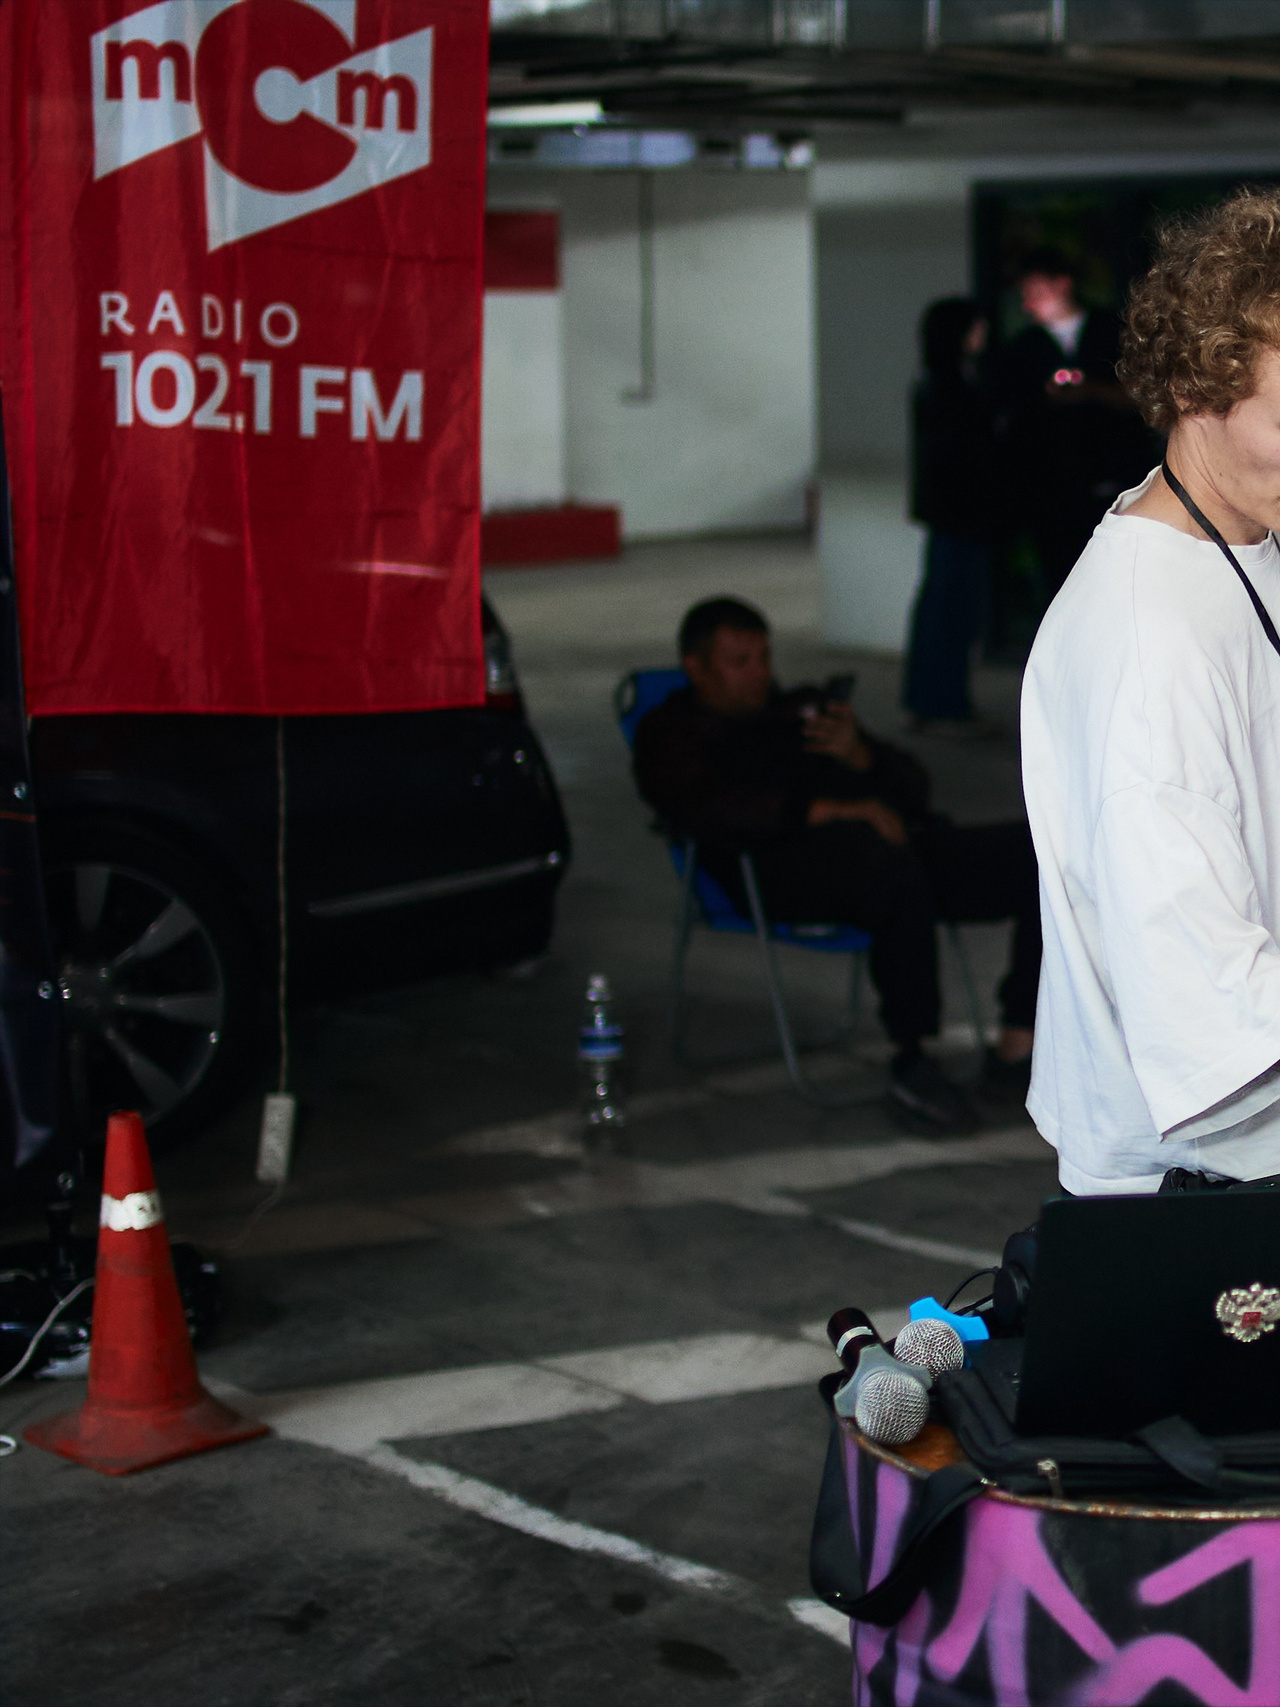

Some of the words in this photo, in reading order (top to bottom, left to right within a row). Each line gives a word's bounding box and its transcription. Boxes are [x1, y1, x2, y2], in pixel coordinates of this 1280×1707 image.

[100, 291, 299, 347] RADIO
[101, 350, 272, 435] 102.1
[299, 364, 424, 442] FM
